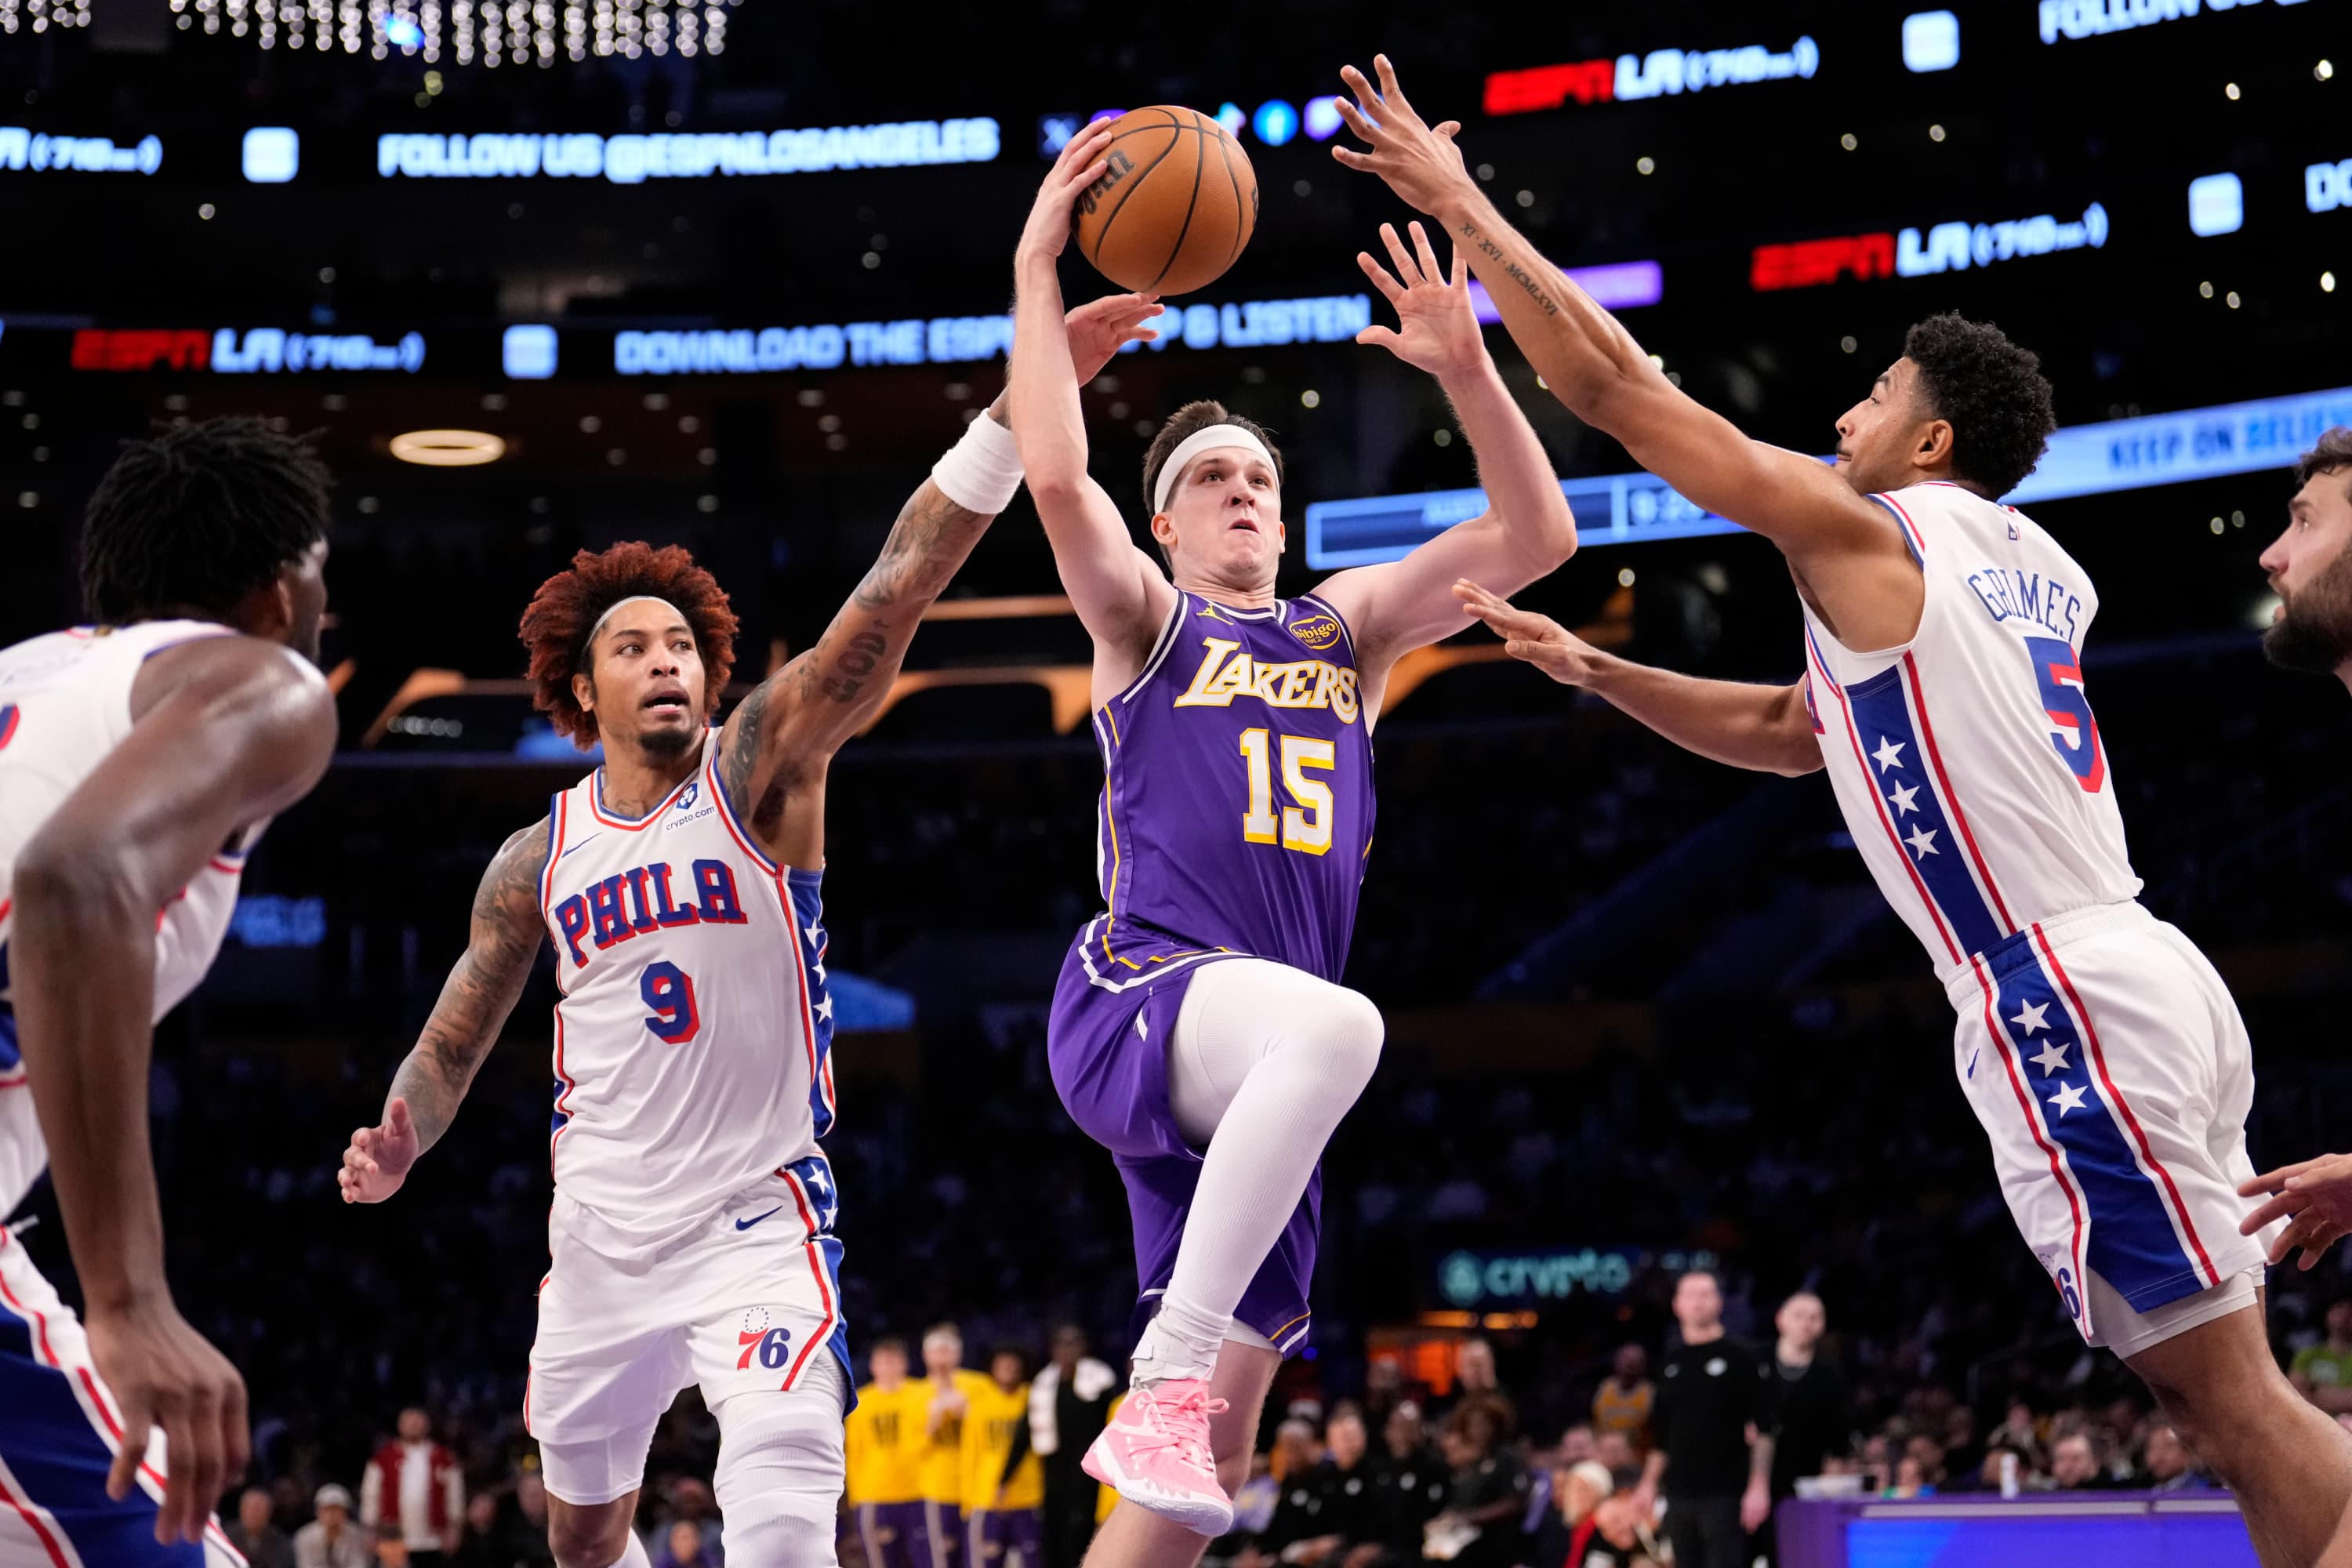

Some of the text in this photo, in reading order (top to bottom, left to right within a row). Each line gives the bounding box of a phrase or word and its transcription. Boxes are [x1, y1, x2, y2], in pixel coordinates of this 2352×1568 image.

[1483, 60, 1613, 115] ESPN
[378, 117, 1000, 183] FOLLOW US @ESPNLOSANGELES
[1460, 223, 1559, 316] XI XVI MCMLXVI
[1751, 233, 1895, 290] ESPN
[615, 325, 845, 374] DOWNLOAD
[846, 320, 927, 365] THE
[1221, 294, 1371, 347] LISTEN
[1292, 622, 1336, 639] bibigo
[1968, 569, 2081, 644] GRIMES
[822, 632, 887, 703] GOD
[1174, 637, 1359, 724] LAKERS
[2024, 637, 2105, 793] 5
[666, 806, 715, 831] crypto.com
[1240, 728, 1335, 856] 15
[554, 859, 749, 969] PHILA
[640, 960, 701, 1044] 9
[2053, 1267, 2081, 1319] 6
[737, 1327, 791, 1371] 76
